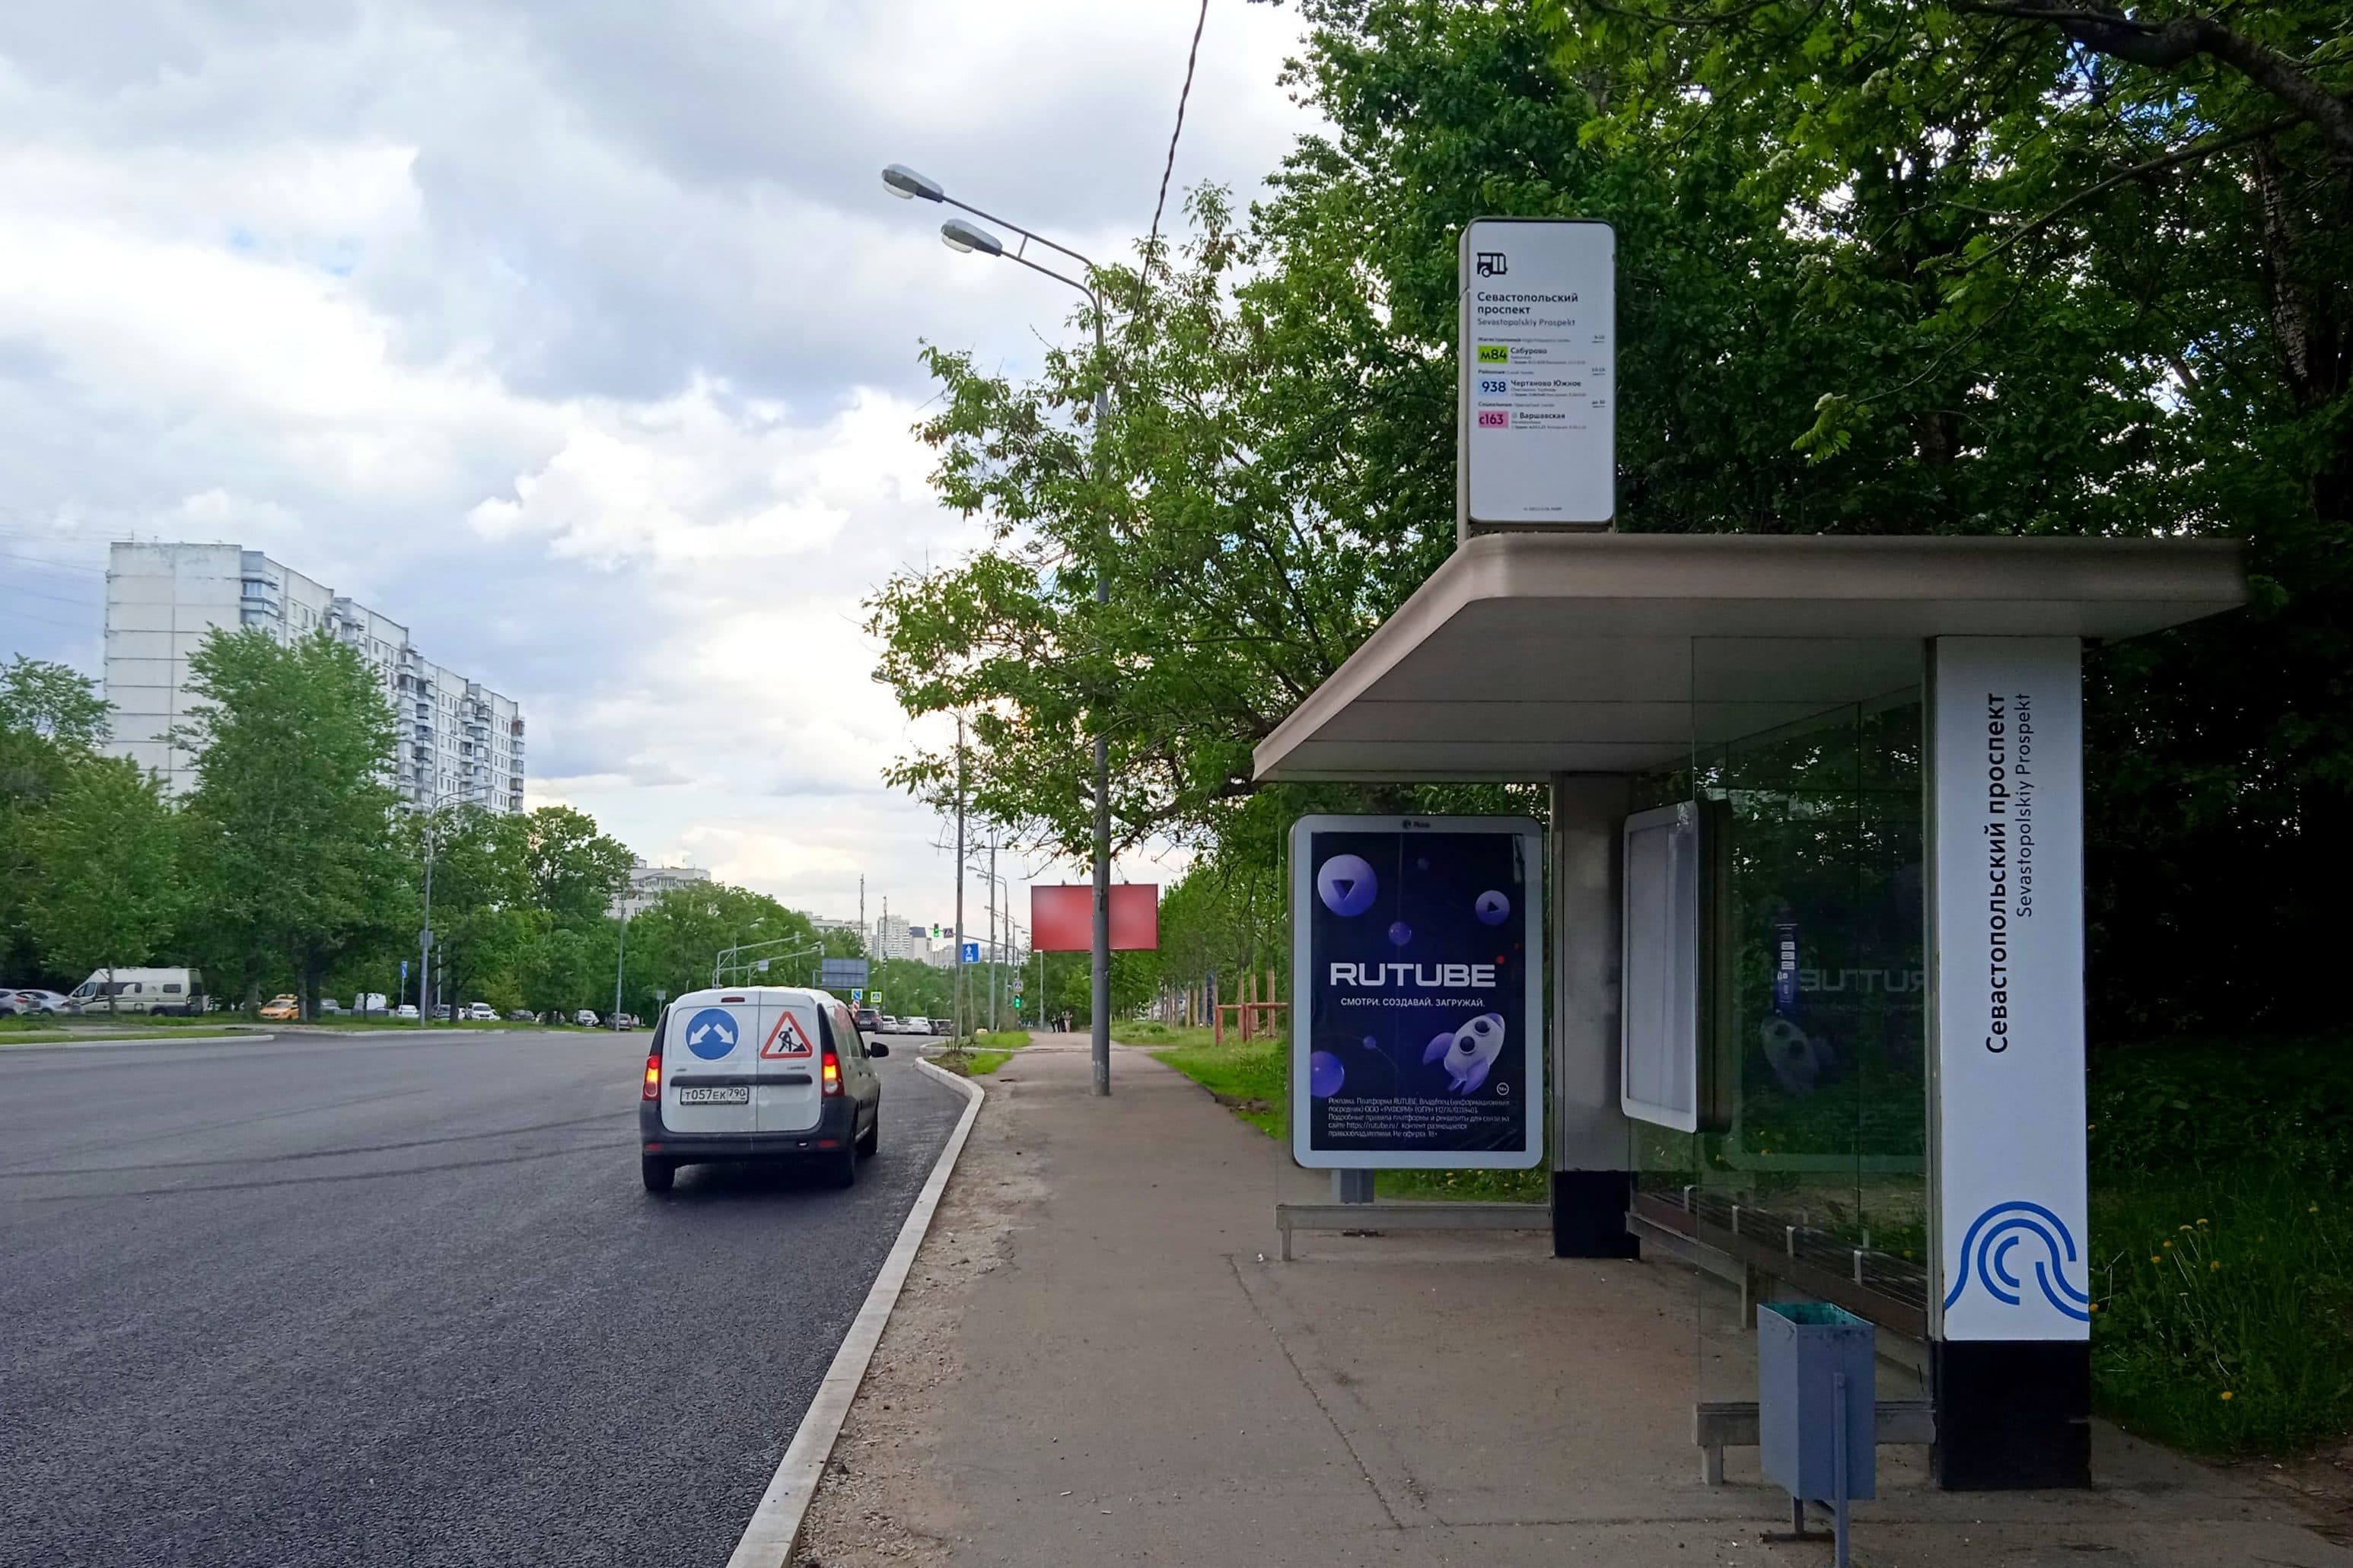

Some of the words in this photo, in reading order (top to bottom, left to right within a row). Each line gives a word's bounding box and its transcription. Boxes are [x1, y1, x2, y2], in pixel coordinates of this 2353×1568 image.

[1477, 291, 1578, 303] Севастопольский
[1478, 306, 1530, 316] проспект
[1477, 318, 1536, 327] Sevastopolskiy
[1539, 318, 1575, 327] Prospekt
[1511, 347, 1547, 356] Сабурово
[1482, 381, 1506, 393] 938
[1520, 412, 1565, 420] Варшавская
[2014, 693, 2034, 775] Prospekt
[1988, 693, 2011, 814] проспект
[2015, 780, 2034, 918] Sevastopolskiy
[1984, 822, 2008, 1054] Севастопольский
[1330, 962, 1496, 988] RUTUBE
[1341, 997, 1380, 1006] СМОТРИ.
[1383, 997, 1433, 1007] СОЗДАВАЙ.
[1435, 997, 1485, 1007] ЗАГРУЖАЙ.
